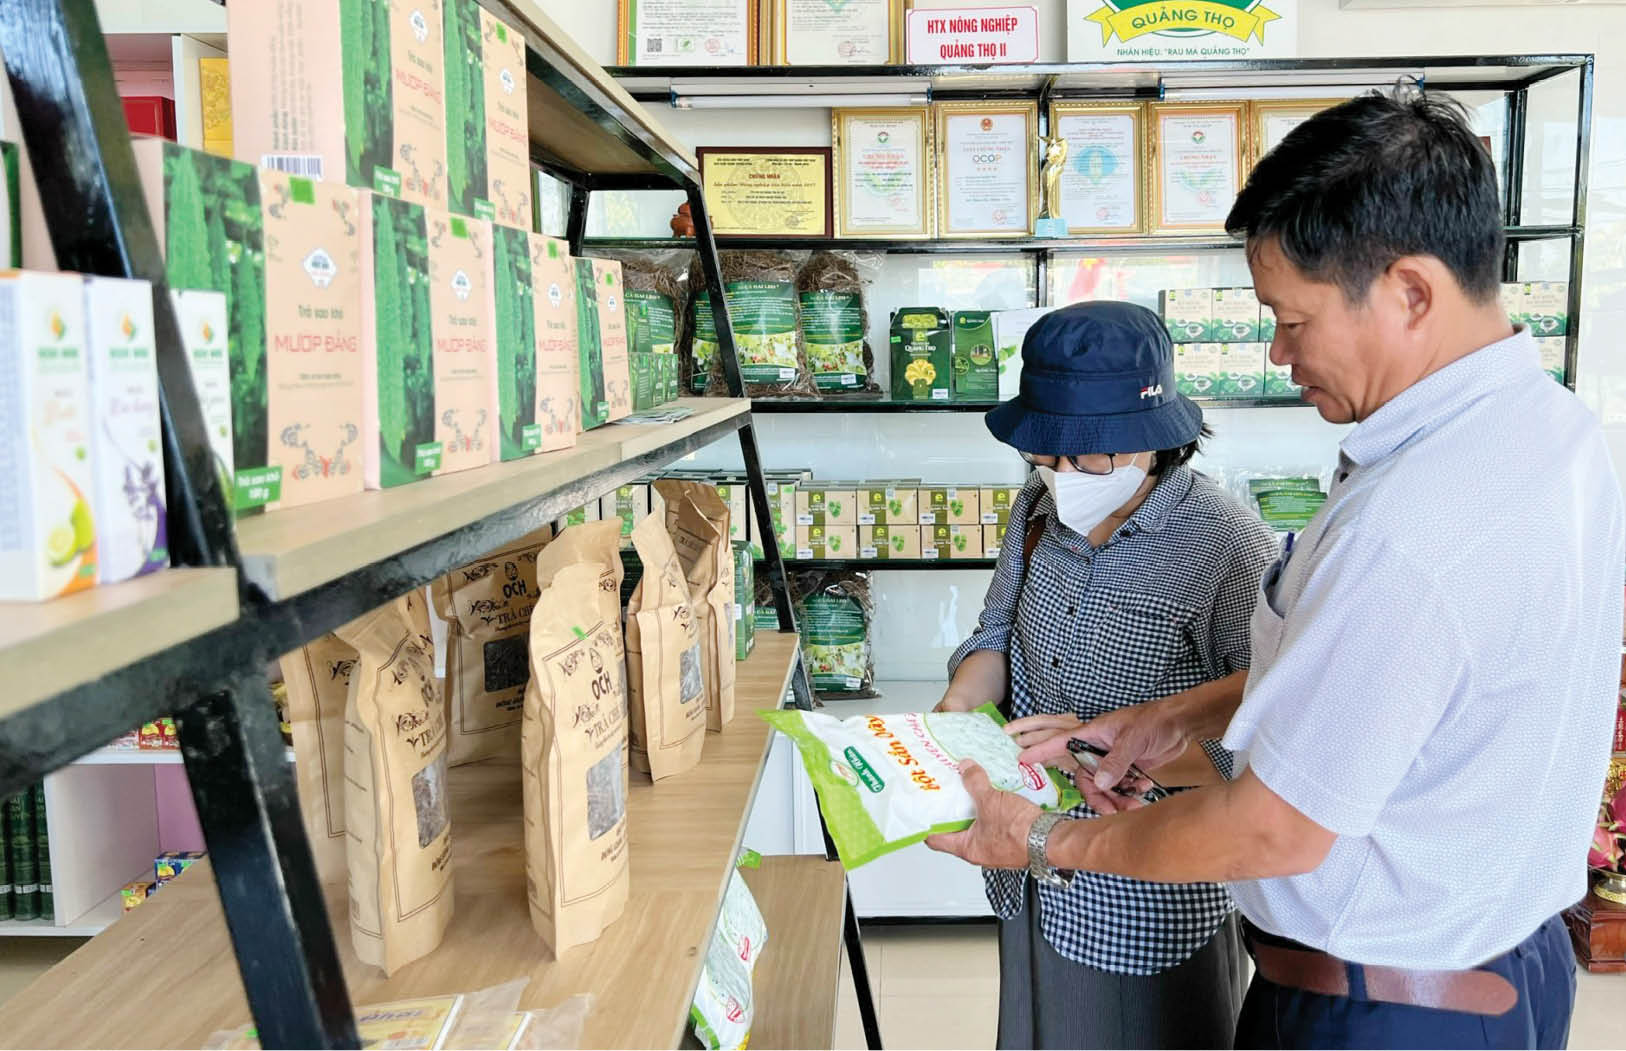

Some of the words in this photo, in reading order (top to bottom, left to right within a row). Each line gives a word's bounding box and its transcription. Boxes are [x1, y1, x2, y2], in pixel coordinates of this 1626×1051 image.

[927, 20, 947, 34] HTX
[949, 15, 978, 34] NÔNG
[981, 13, 1018, 36] NGHIỆP
[1132, 6, 1198, 29] QUẢNG
[1204, 10, 1236, 30] THỌ
[940, 39, 975, 60] QUẢNG
[977, 42, 997, 60] THỌ
[1000, 42, 1007, 57] II
[1200, 45, 1231, 57] QUẢNG
[1140, 384, 1163, 400] FILA
[502, 579, 527, 599] OCH
[591, 670, 613, 700] OCH
